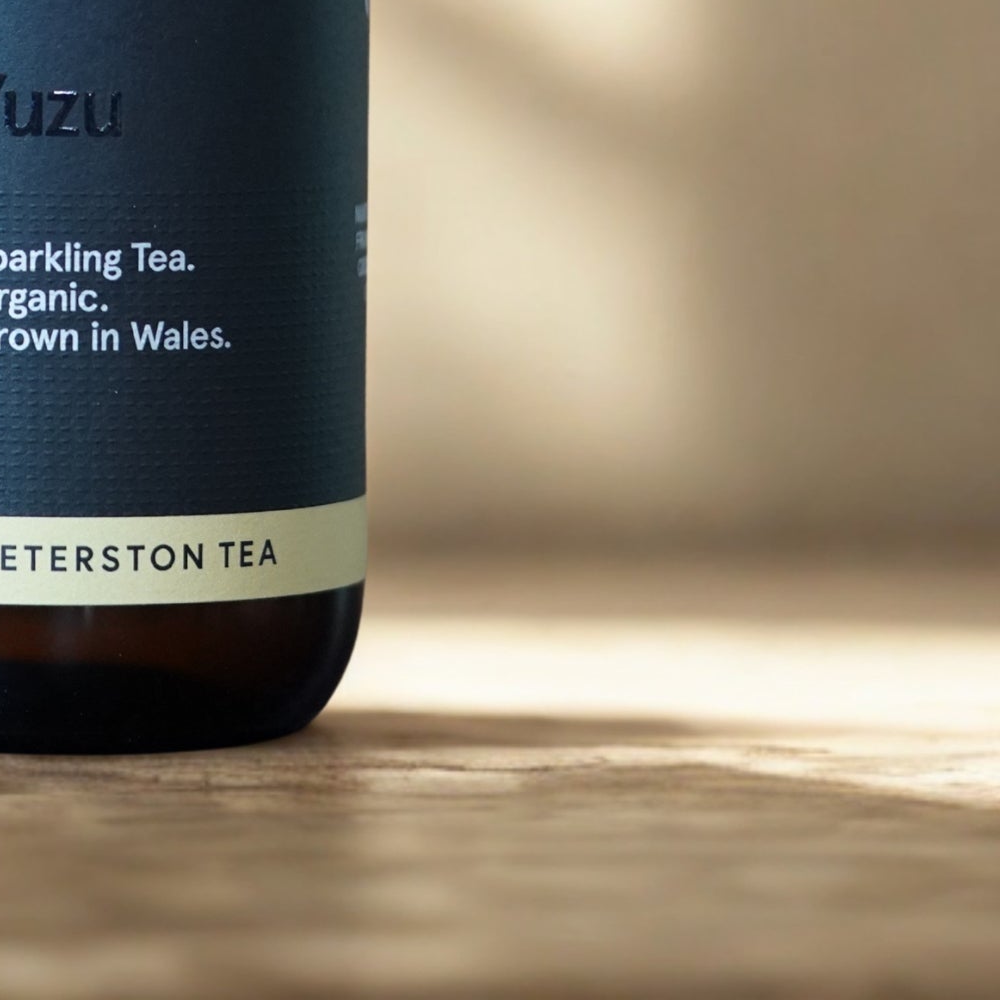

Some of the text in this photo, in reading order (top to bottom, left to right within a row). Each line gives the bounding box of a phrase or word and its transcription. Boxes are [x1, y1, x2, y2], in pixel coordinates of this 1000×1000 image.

[130, 242, 195, 272] Tea.
[91, 320, 119, 351] in
[130, 320, 231, 351] Wales.
[218, 539, 277, 569] TEA
